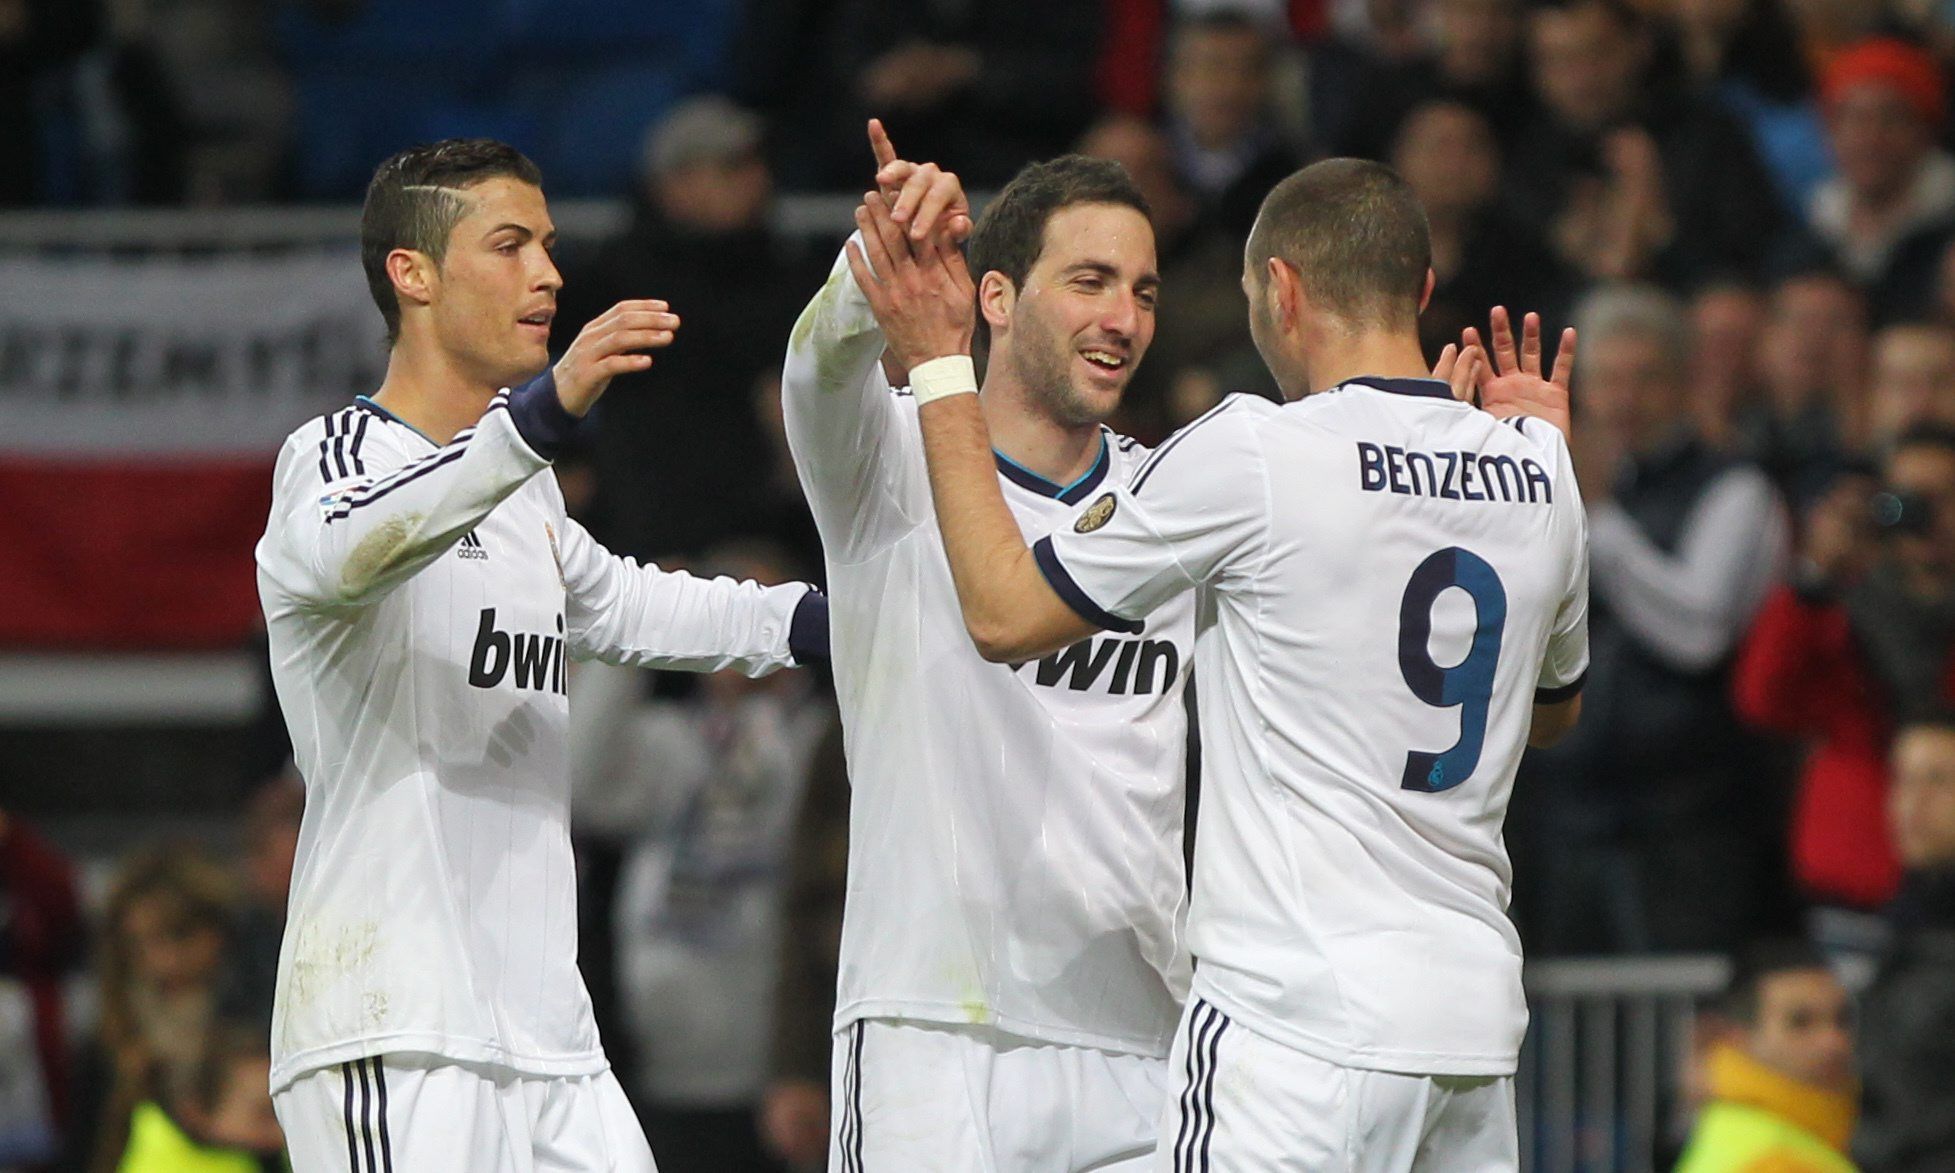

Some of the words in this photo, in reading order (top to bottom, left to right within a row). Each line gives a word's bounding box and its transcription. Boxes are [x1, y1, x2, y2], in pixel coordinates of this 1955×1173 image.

[1357, 441, 1552, 504] BENZEMA
[457, 547, 489, 560] adidas
[468, 608, 567, 696] bwi
[1008, 626, 1178, 695] win
[1399, 546, 1507, 793] 9
